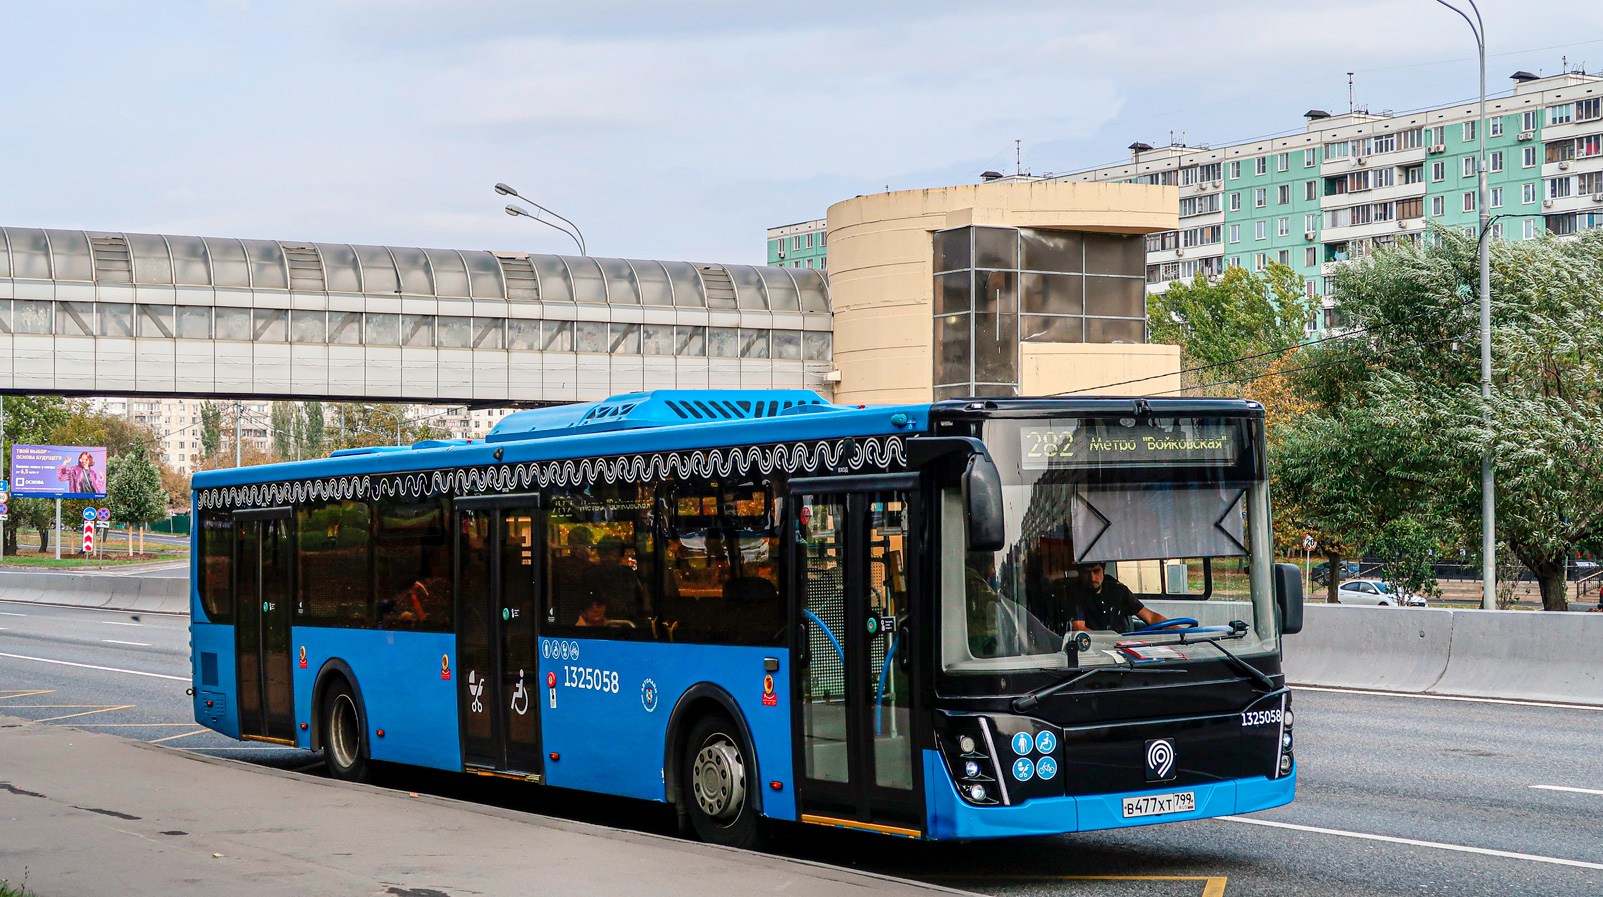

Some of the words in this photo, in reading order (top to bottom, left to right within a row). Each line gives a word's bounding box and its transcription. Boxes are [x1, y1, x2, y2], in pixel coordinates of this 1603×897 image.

[1026, 431, 1075, 458] 282
[1089, 436, 1137, 452] Метро
[1142, 435, 1227, 450] "Войковская"
[564, 665, 620, 694] 1325058
[1241, 709, 1282, 726] 1325058
[1174, 793, 1192, 806] 799
